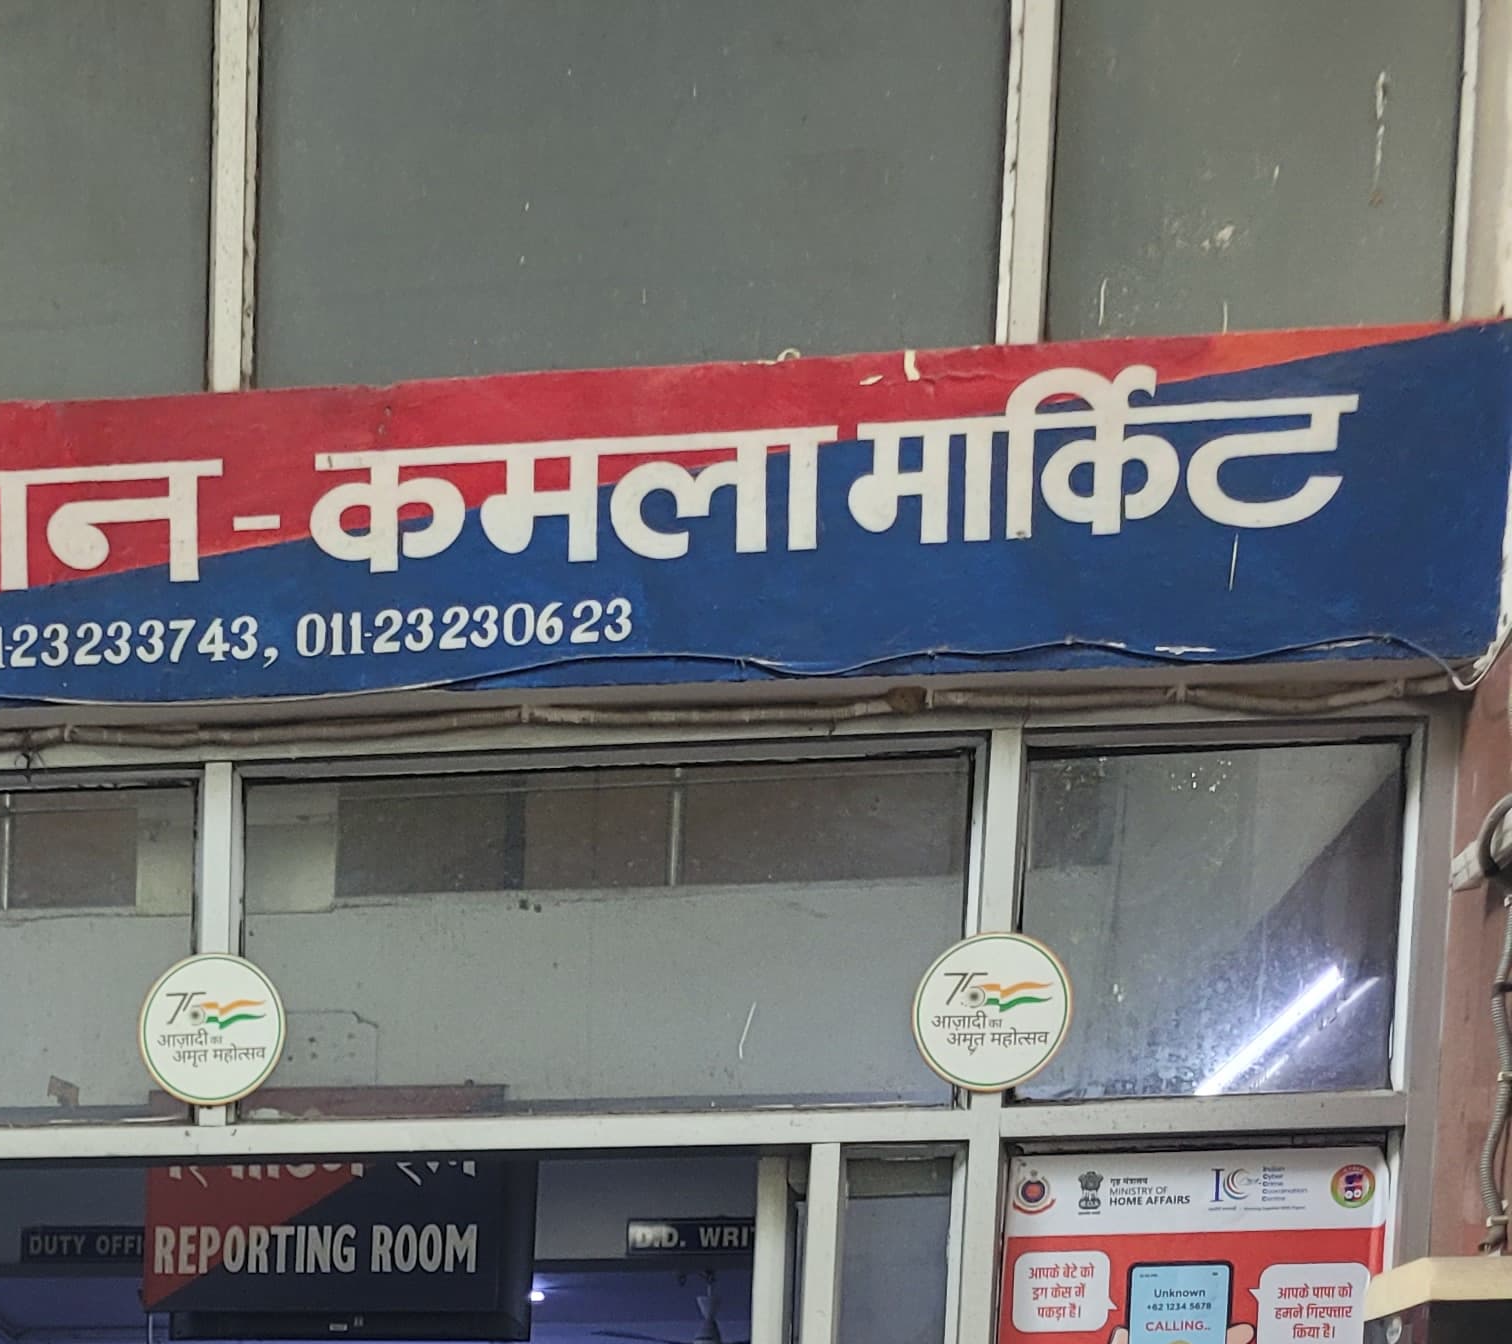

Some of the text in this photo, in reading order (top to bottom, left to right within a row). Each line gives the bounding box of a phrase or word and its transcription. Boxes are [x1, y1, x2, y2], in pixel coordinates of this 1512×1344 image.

[310, 425, 839, 574] कमला
[848, 365, 1360, 544] मार्किट
[946, 1027, 1050, 1056] अमृत महोत्सव
[172, 1044, 267, 1068] अमृत महोत्सव
[1109, 1185, 1168, 1196] MINISTRY OF
[1109, 1195, 1191, 1206] HOME AFFAIRS
[28, 1235, 86, 1257] DUTY
[153, 1223, 479, 1276] REPORTING ROOM
[1028, 1262, 1095, 1280] आपके बेटे को
[1049, 1282, 1086, 1300] केस में
[1153, 1288, 1206, 1299] Unknown
[1277, 1282, 1353, 1300] आपके पापा को
[1037, 1305, 1065, 1322] पकड़ा
[1146, 1302, 1212, 1312] +62 1234 5678
[1274, 1303, 1303, 1320] हमने
[1292, 1323, 1320, 1340] किया
